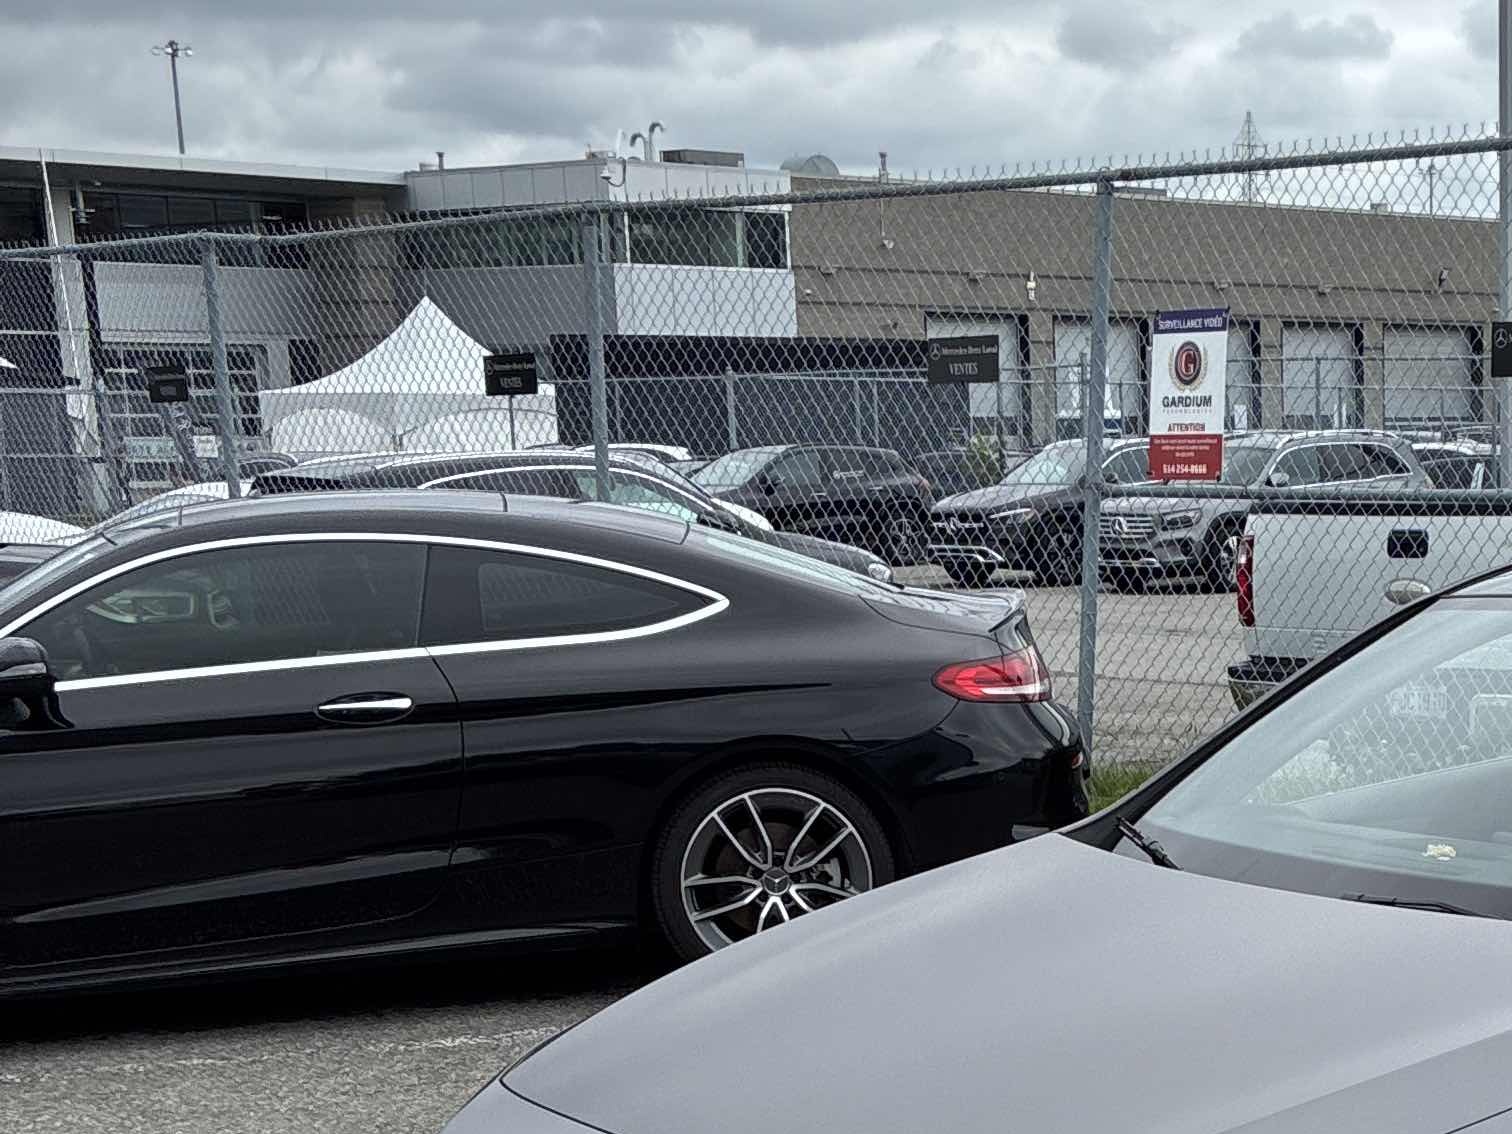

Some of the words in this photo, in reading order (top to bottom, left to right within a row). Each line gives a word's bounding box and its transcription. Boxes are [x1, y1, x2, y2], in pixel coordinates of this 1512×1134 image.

[949, 362, 978, 375] VENTES
[1162, 395, 1212, 408] GARDIUM
[1168, 423, 1206, 432] ATTENTION
